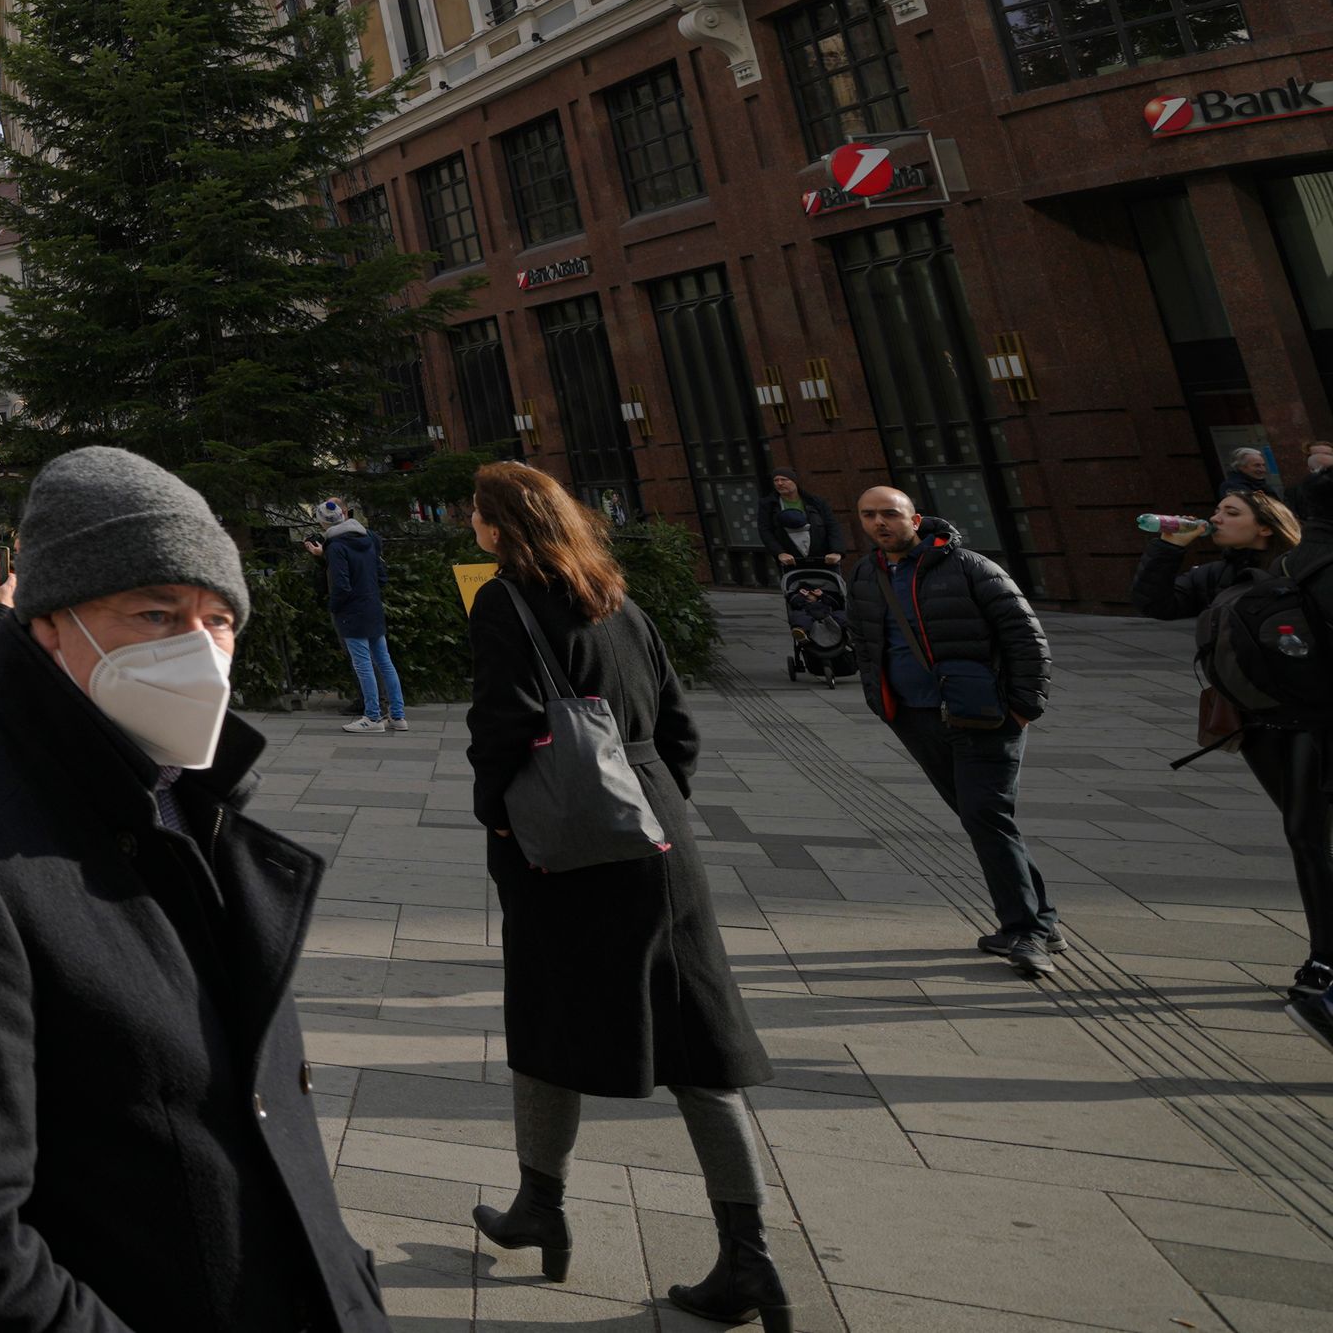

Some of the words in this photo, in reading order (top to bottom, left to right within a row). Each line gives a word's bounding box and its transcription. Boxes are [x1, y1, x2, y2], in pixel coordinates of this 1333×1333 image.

[1197, 77, 1323, 123] Bank
[528, 268, 551, 284] Bank
[552, 259, 585, 278] Austria
